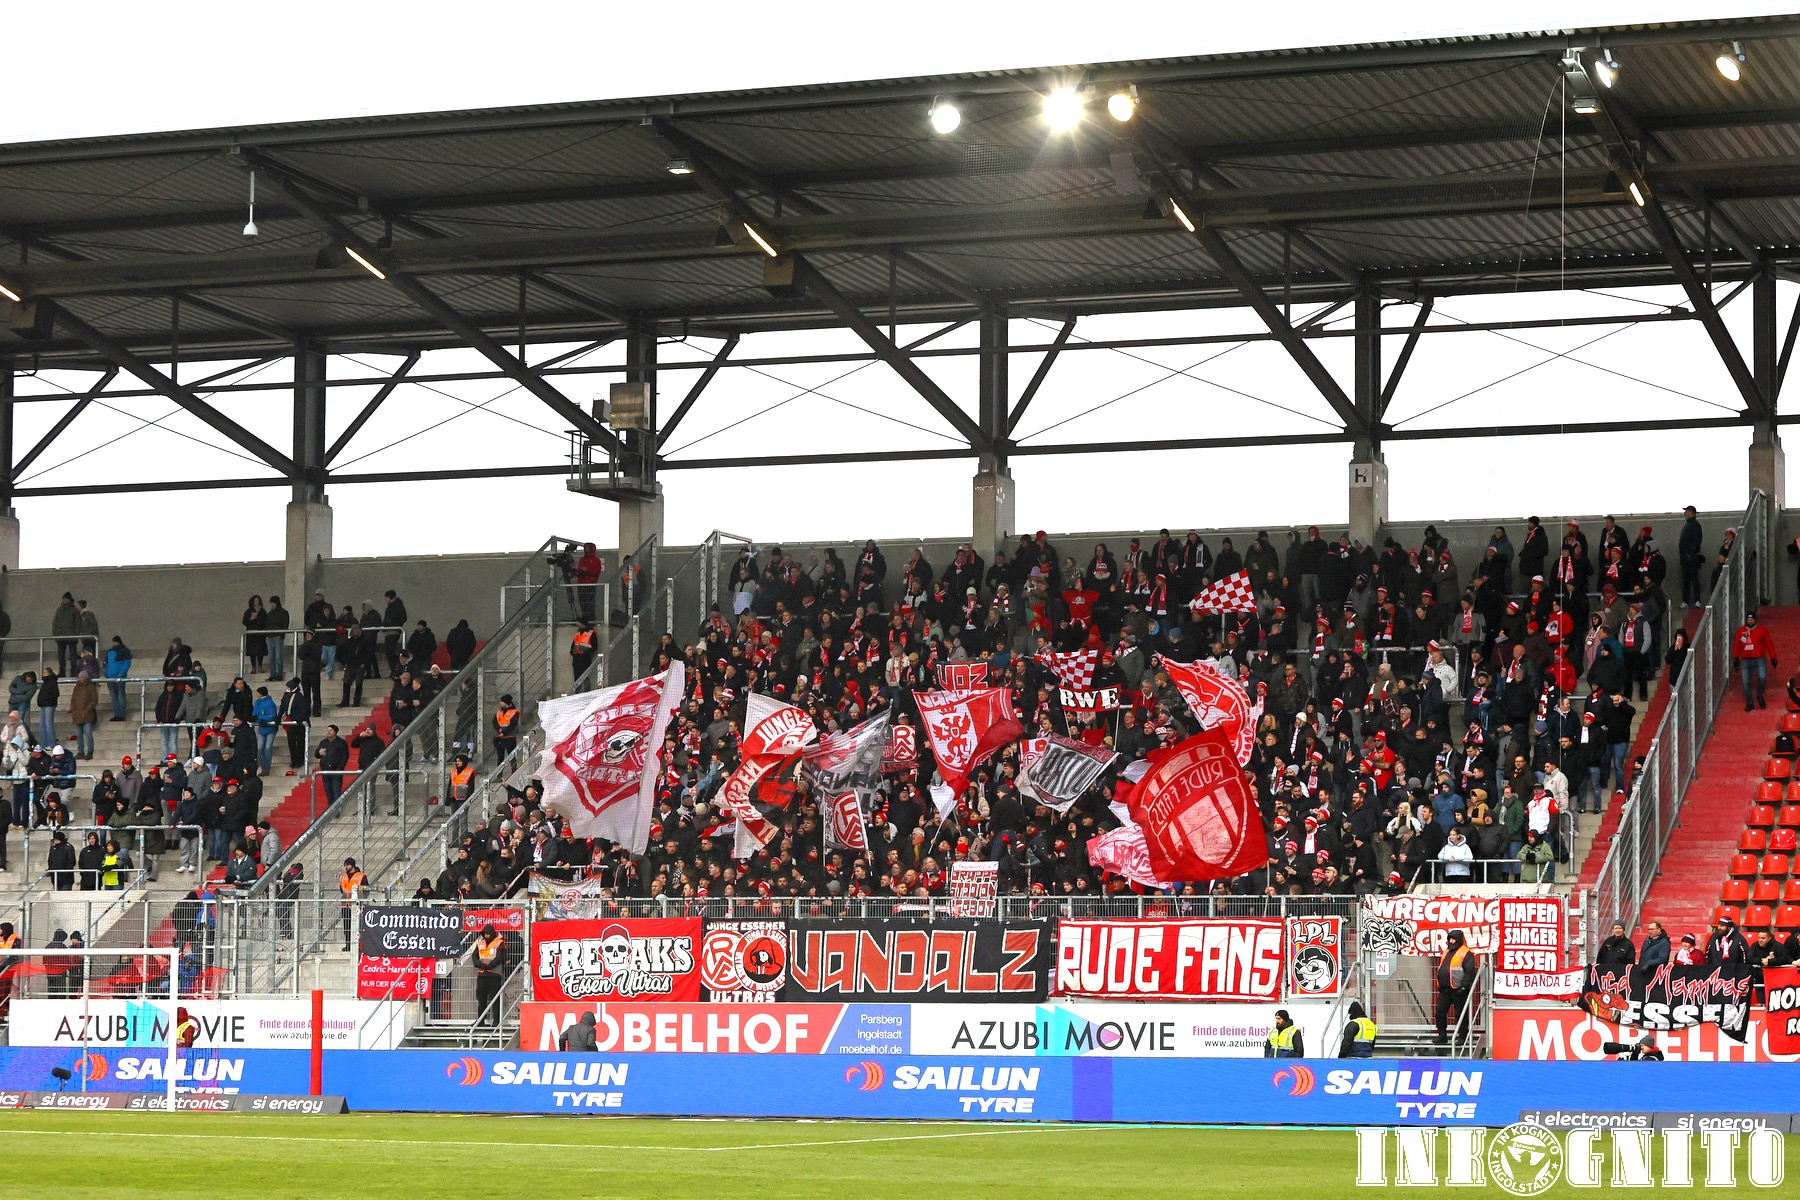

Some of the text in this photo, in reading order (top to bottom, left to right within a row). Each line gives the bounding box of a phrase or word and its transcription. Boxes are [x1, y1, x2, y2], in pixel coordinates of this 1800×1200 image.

[1060, 688, 1119, 710] RWE
[364, 909, 459, 930] Commando
[1373, 898, 1500, 924] WRECKING
[1504, 902, 1558, 922] HAFEN
[706, 922, 785, 930] JUNGE ESSENER
[1292, 921, 1336, 946] LPL
[383, 930, 436, 950] Essen
[1415, 924, 1492, 952] CRW
[539, 938, 694, 978] FREAKS
[790, 928, 1040, 993] VANDALZ
[1058, 926, 1283, 994] RUDE FANS
[1504, 951, 1557, 972] ESSEN
[363, 966, 387, 974] Cedric
[1378, 964, 1386, 972] N
[361, 980, 375, 988] NUR
[562, 969, 672, 999] Essen Ultras
[1506, 975, 1520, 988] LA
[1564, 974, 1571, 986] E
[1646, 964, 1751, 1006] Mambas
[710, 991, 776, 1003] ULTRAS
[260, 1020, 281, 1029] Finde
[282, 1020, 305, 1029] deine
[860, 1014, 902, 1026] Parsberg
[1620, 1000, 1747, 1031] ESSEN
[54, 1016, 136, 1042] AZUBI
[857, 1029, 902, 1040] Ingolstadt
[952, 1020, 1174, 1051] AZUBI MOVIE
[1192, 1026, 1218, 1036] Finde
[1220, 1026, 1246, 1036] deine
[839, 1044, 902, 1054] moebelhof.de
[491, 1061, 628, 1086] SAILUN
[892, 1066, 1040, 1091] SAILUN
[1324, 1070, 1483, 1096] SAILUN
[41, 1094, 110, 1108] si energy
[131, 1093, 146, 1108] si
[252, 1096, 324, 1114] si energy
[552, 1092, 624, 1108] TYRE
[958, 1097, 1034, 1113] TYRE
[1396, 1102, 1477, 1118] TYRE
[1524, 1111, 1647, 1127] si electronics
[1678, 1114, 1766, 1132] si energy
